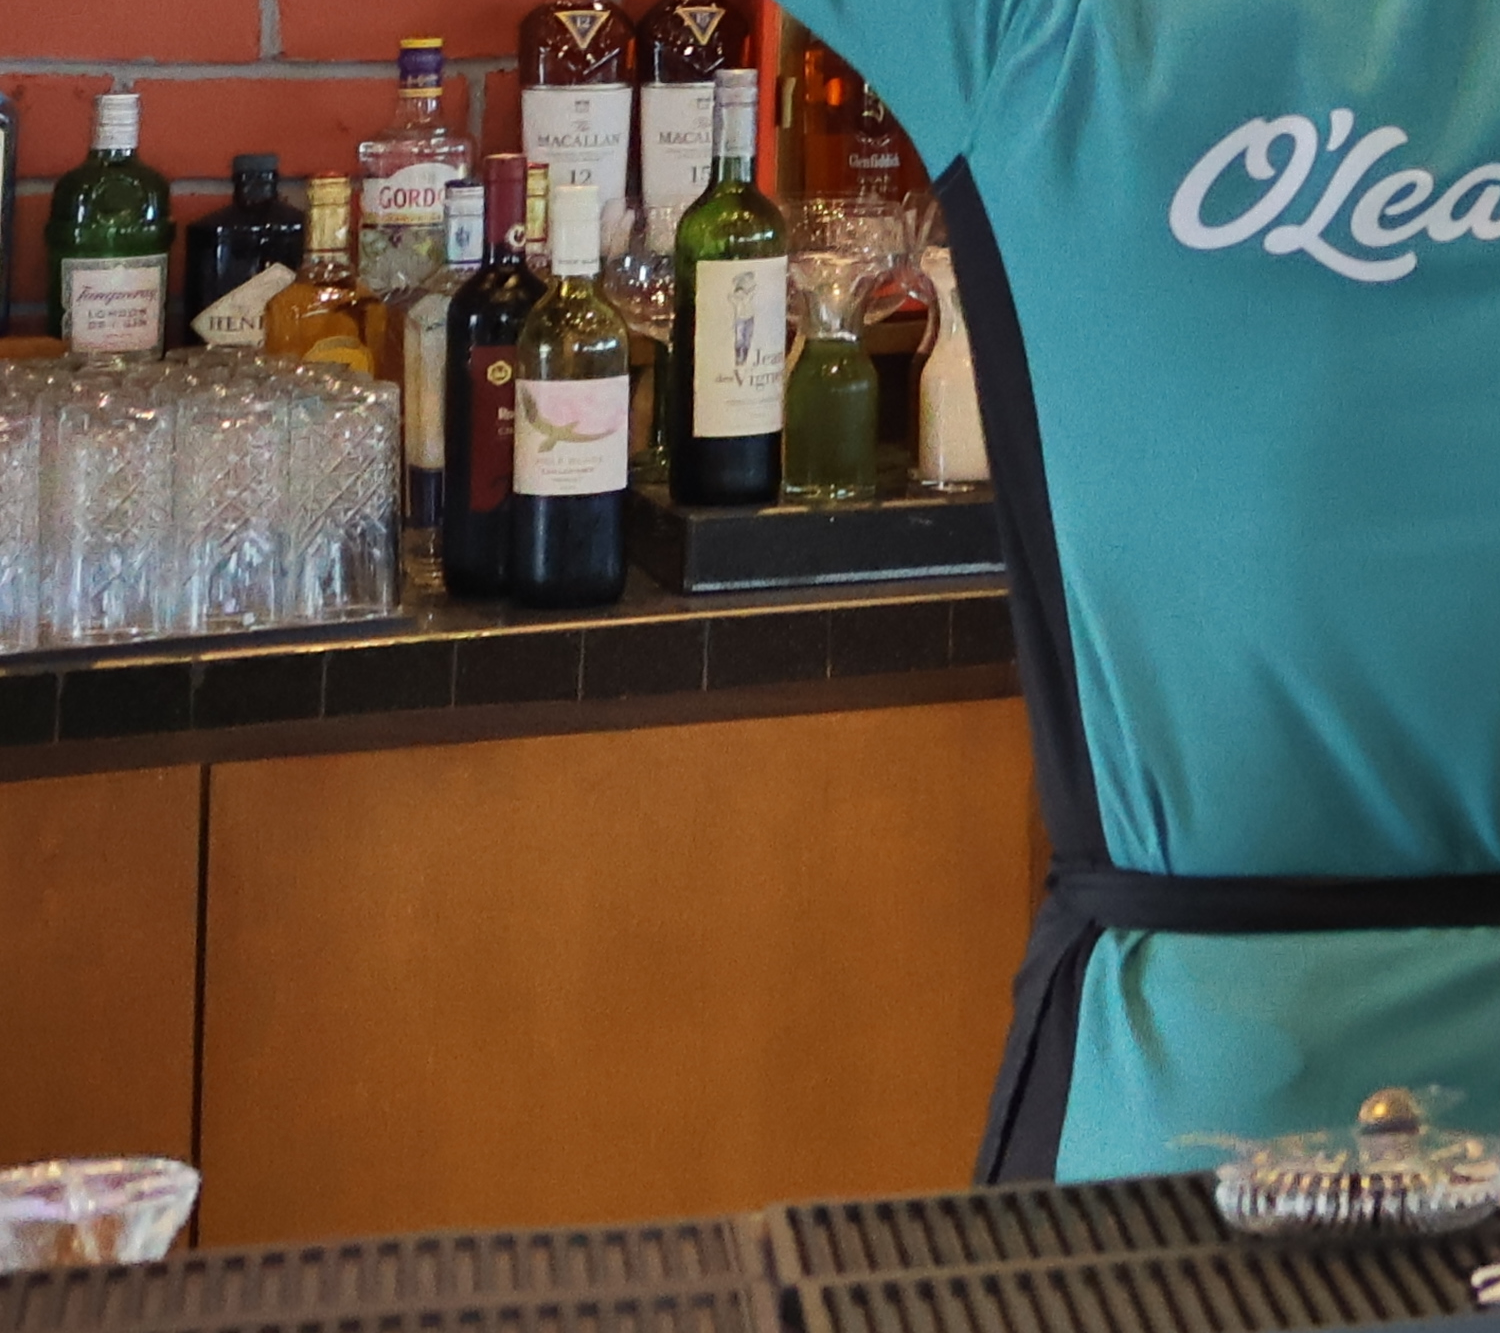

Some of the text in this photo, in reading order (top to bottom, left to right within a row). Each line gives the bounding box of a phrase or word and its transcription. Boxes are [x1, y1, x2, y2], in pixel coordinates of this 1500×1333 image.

[537, 133, 622, 148] MACALLAN
[658, 131, 713, 145] MACAL
[848, 152, 901, 169] Glenfiddich
[569, 168, 592, 185] 12
